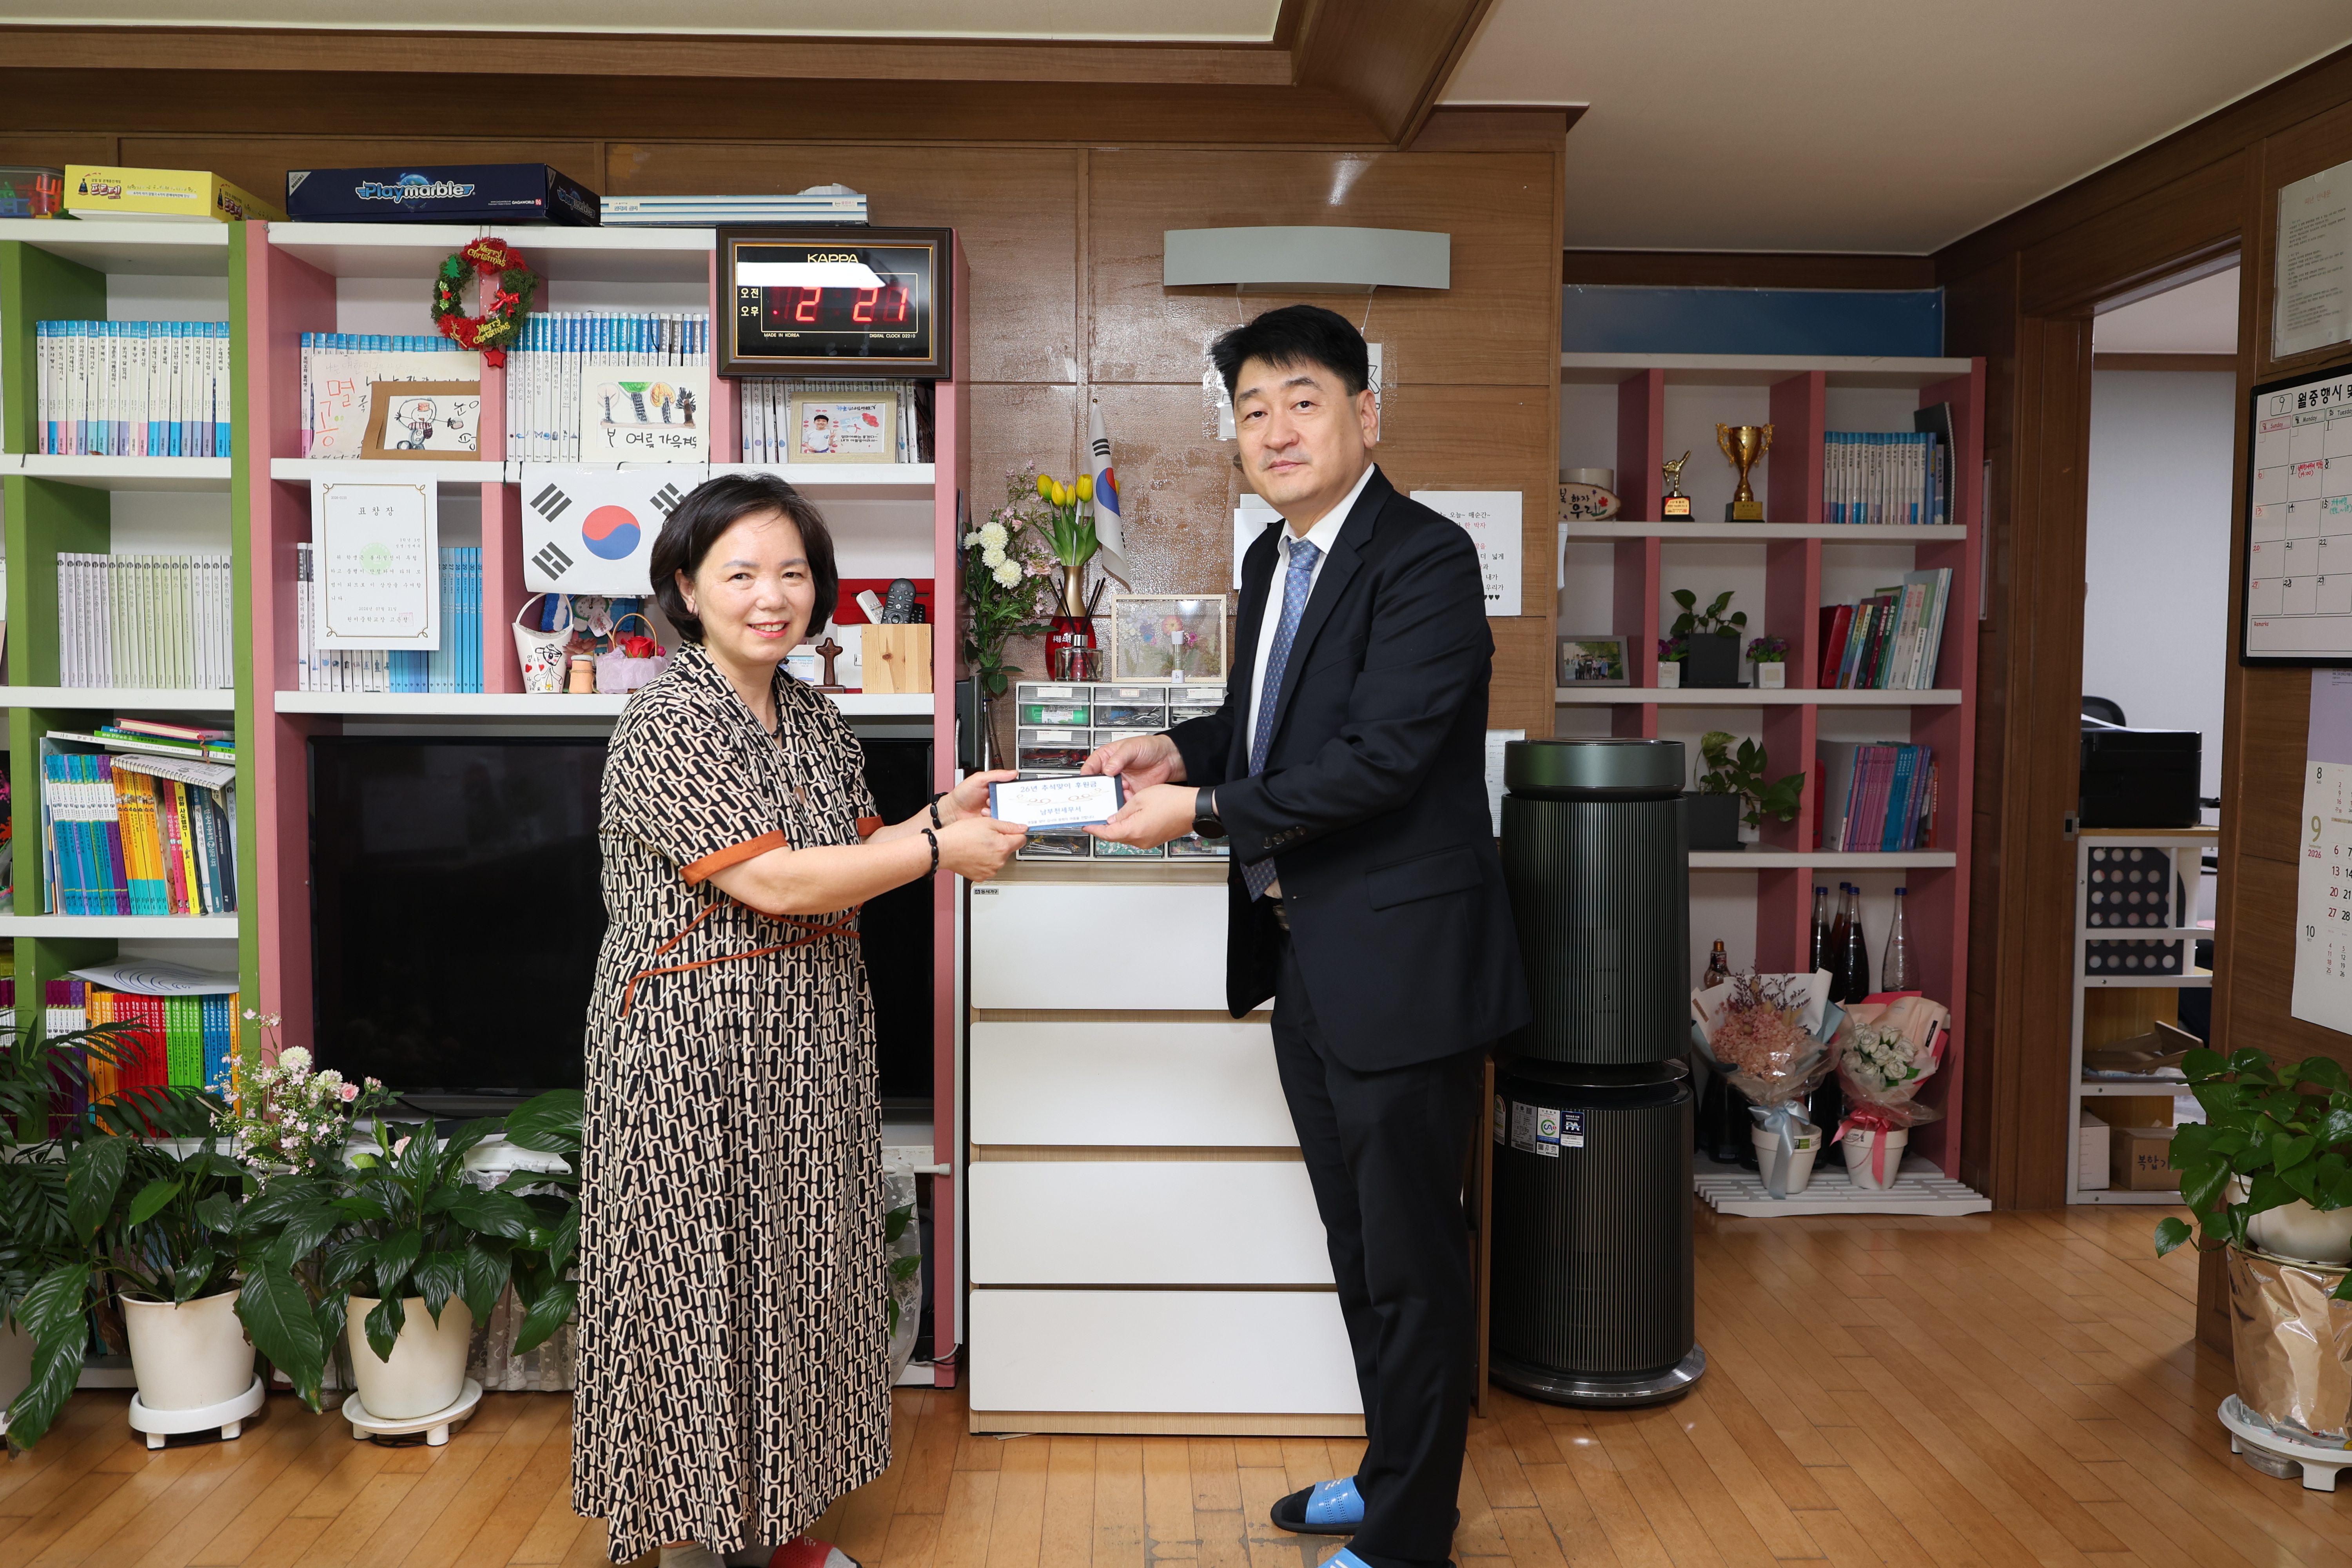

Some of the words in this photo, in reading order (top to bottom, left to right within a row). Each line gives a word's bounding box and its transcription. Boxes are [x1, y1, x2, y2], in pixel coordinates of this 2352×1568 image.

[363, 181, 466, 203] Playmarble
[478, 242, 503, 260] Merry
[467, 249, 507, 267] Christmas
[808, 253, 859, 263] KAPPA
[740, 288, 759, 299] 오전
[740, 306, 759, 317] 오후
[476, 317, 501, 333] Merry
[473, 322, 510, 344] Christmas
[2279, 396, 2285, 413] 9
[2324, 459, 2329, 469] 8
[2290, 465, 2295, 475] 7
[1572, 494, 1590, 503] 하자
[2321, 499, 2328, 508] 15
[358, 506, 394, 516] 표창장
[2283, 579, 2292, 588] 28
[2318, 576, 2325, 585] 29
[2316, 767, 2323, 779] 8
[1041, 782, 1071, 792] 추석맞이
[1075, 781, 1098, 789] 후원금
[178, 796, 185, 806] 만화
[1040, 806, 1082, 816] 남부천세무서
[2311, 815, 2322, 842] 9
[2308, 849, 2322, 859] 2026
[2334, 845, 2339, 855] 6
[2332, 866, 2340, 877] 13
[2329, 887, 2339, 897] 20
[2343, 889, 2351, 900] 21
[2328, 907, 2337, 918] 27
[2341, 910, 2350, 921] 28
[2306, 925, 2315, 938] 10
